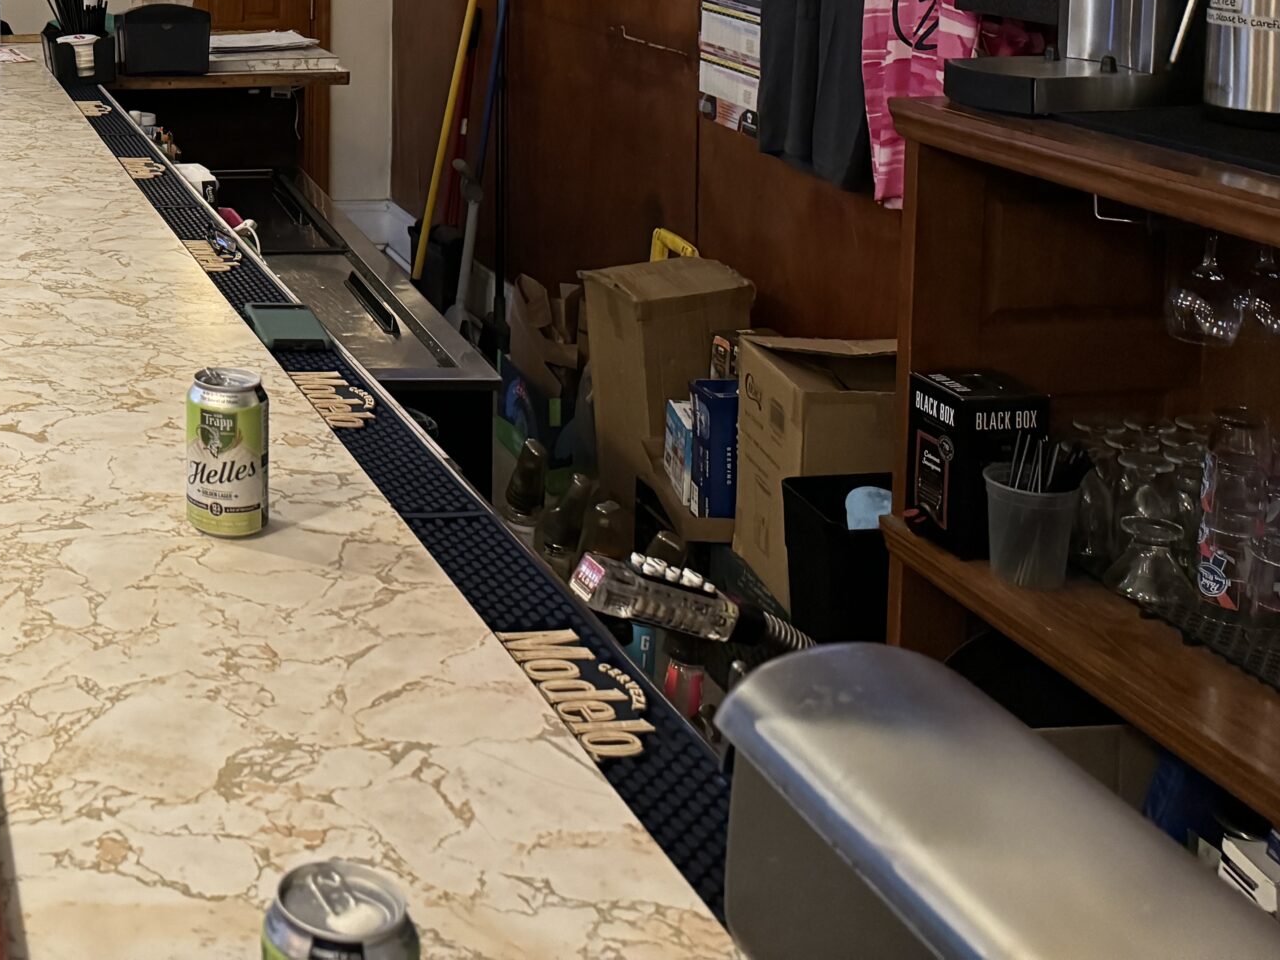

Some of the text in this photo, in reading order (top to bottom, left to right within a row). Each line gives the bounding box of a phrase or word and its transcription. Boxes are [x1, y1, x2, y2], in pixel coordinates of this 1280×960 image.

[1237, 15, 1247, 25] be
[915, 390, 955, 428] BLACK BOX
[975, 410, 1038, 431] BLACK BOX
[202, 412, 234, 432] Trapp
[188, 460, 257, 485] Helles
[495, 628, 656, 757] Modelo
